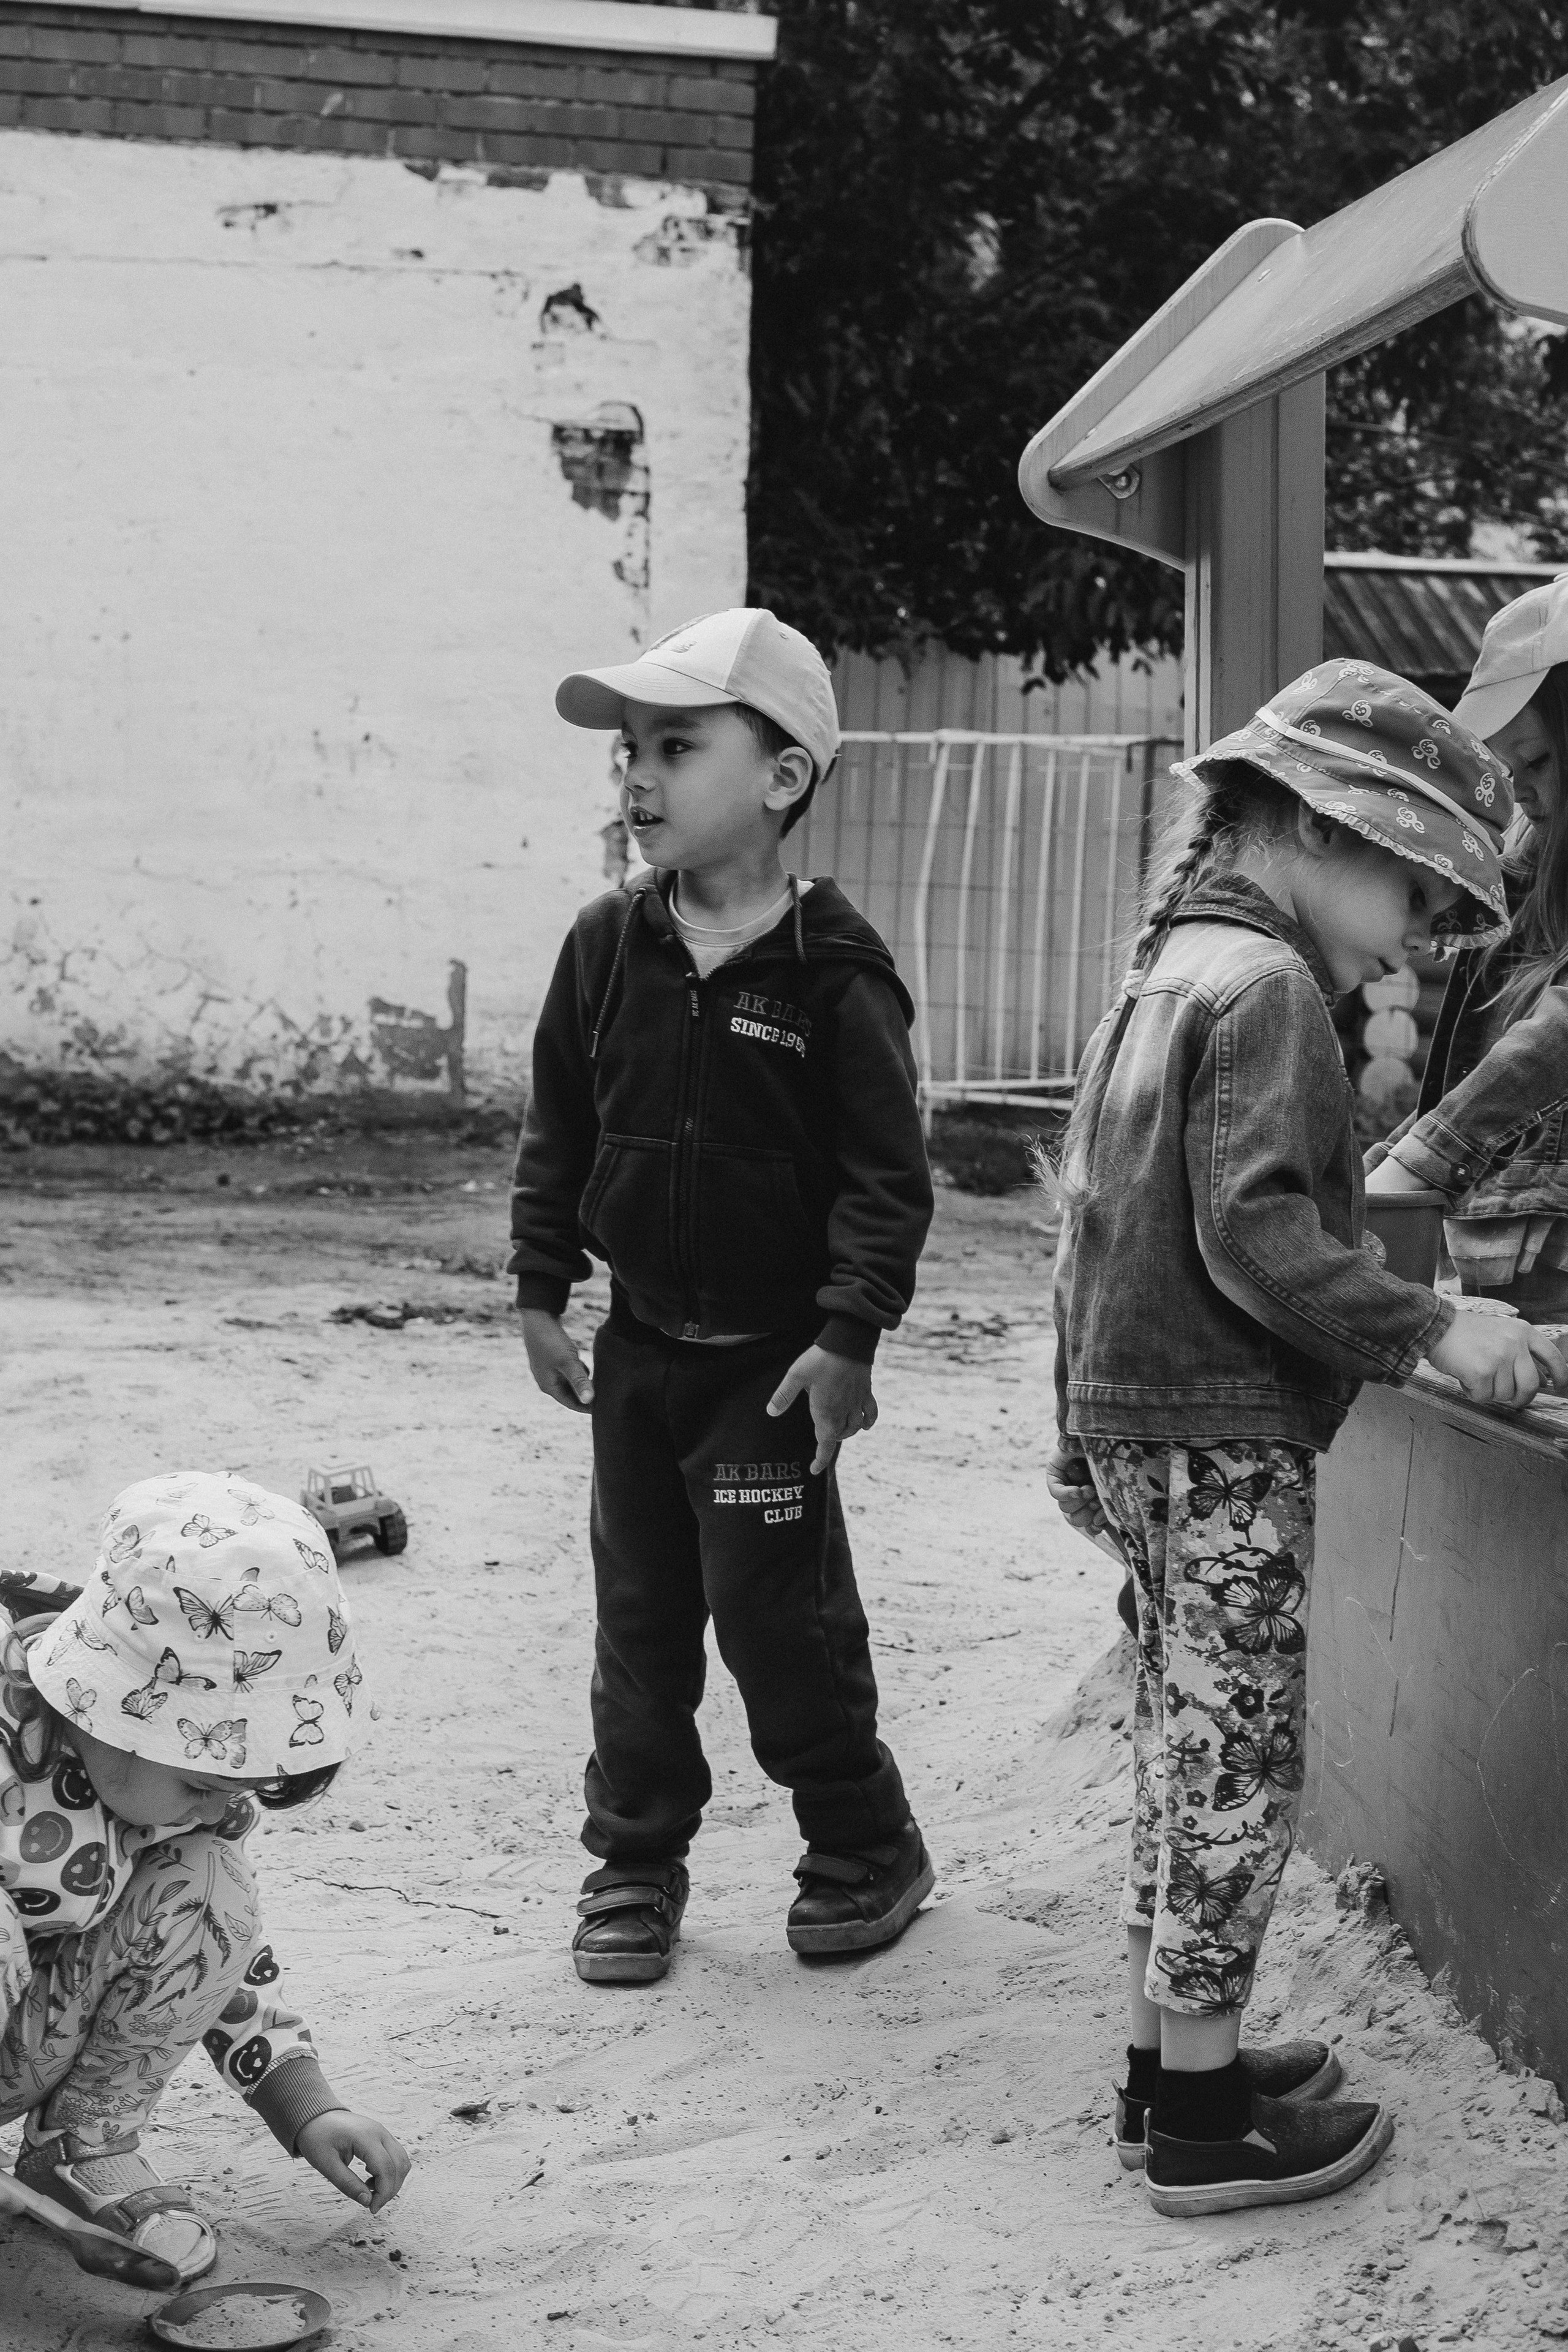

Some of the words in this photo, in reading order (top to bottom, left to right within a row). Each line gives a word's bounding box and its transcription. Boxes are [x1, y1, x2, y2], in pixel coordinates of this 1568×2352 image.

[733, 991, 769, 1015] AK
[730, 1017, 780, 1042] SINCE
[713, 1463, 741, 1481] AK
[744, 1461, 801, 1481] BARS
[713, 1489, 737, 1503] ICE
[738, 1485, 805, 1504] HOCKEY
[764, 1505, 803, 1524] CLUB
